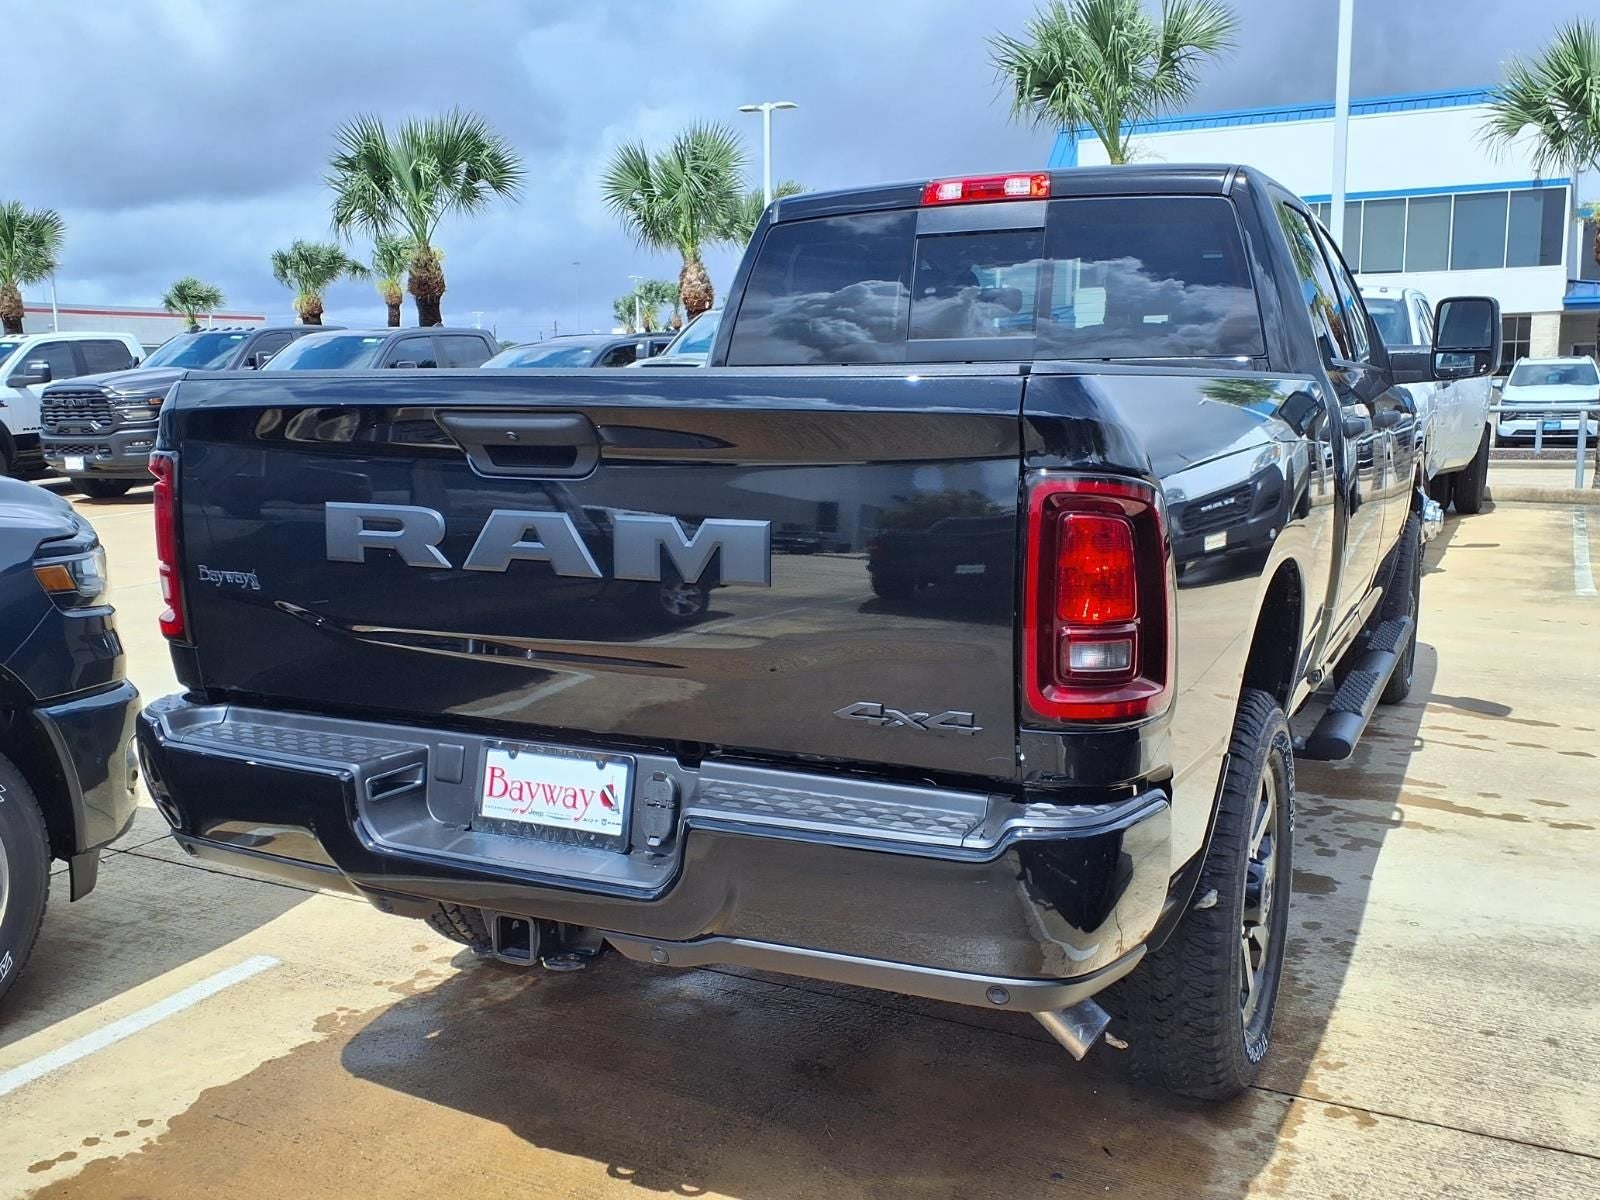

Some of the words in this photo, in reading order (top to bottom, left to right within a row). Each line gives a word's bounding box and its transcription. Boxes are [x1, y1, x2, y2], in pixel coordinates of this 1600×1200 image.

[325, 501, 772, 587] RAM
[197, 564, 252, 590] Bayway
[486, 765, 596, 823] Bayway
